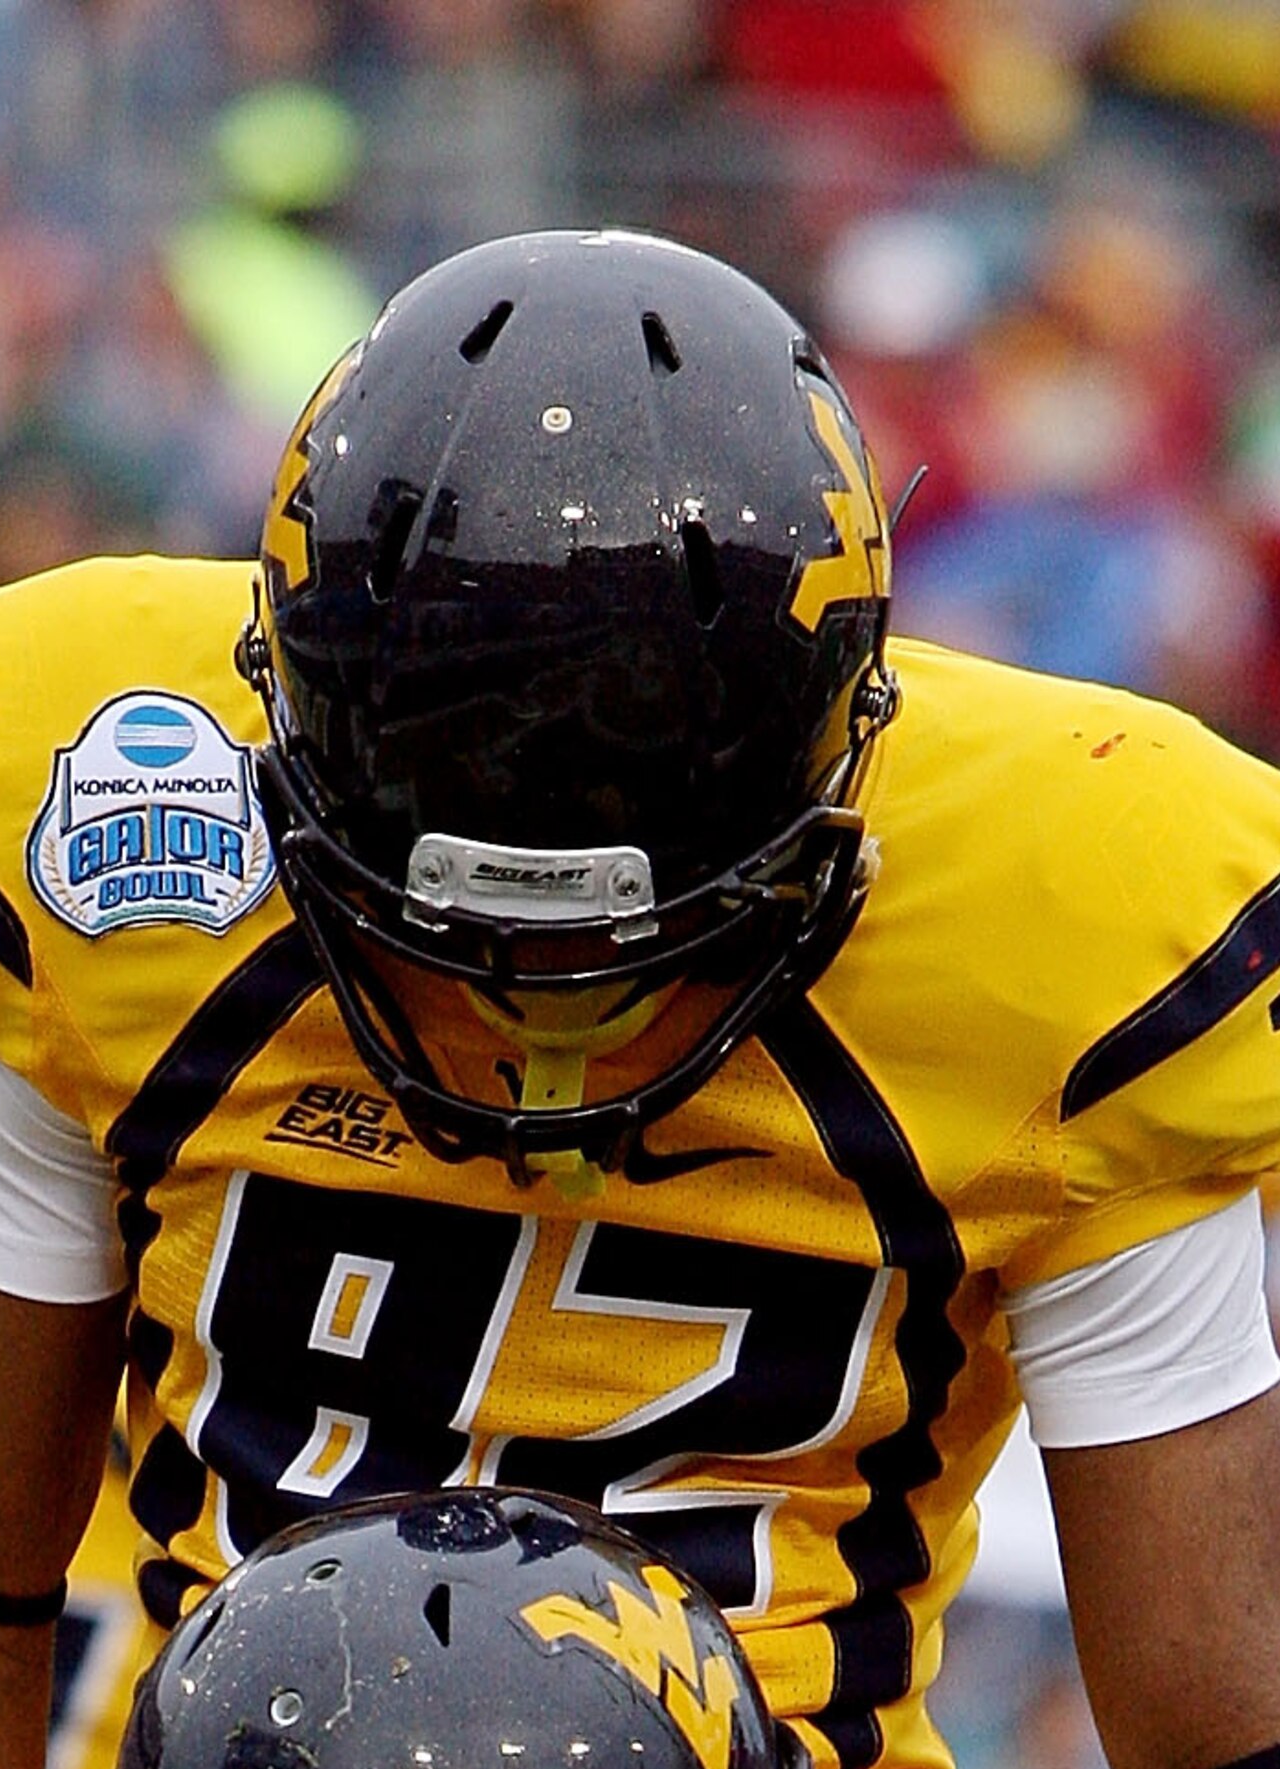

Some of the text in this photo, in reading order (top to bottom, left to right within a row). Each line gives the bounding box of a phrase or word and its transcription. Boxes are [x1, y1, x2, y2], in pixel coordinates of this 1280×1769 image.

[74, 776, 238, 796] KONICA MINOLTA
[67, 804, 245, 886] GATOR
[97, 870, 219, 911] BOWL
[297, 1083, 394, 1124] BIG
[276, 1105, 413, 1157] EAST
[185, 1170, 908, 1620] 82
